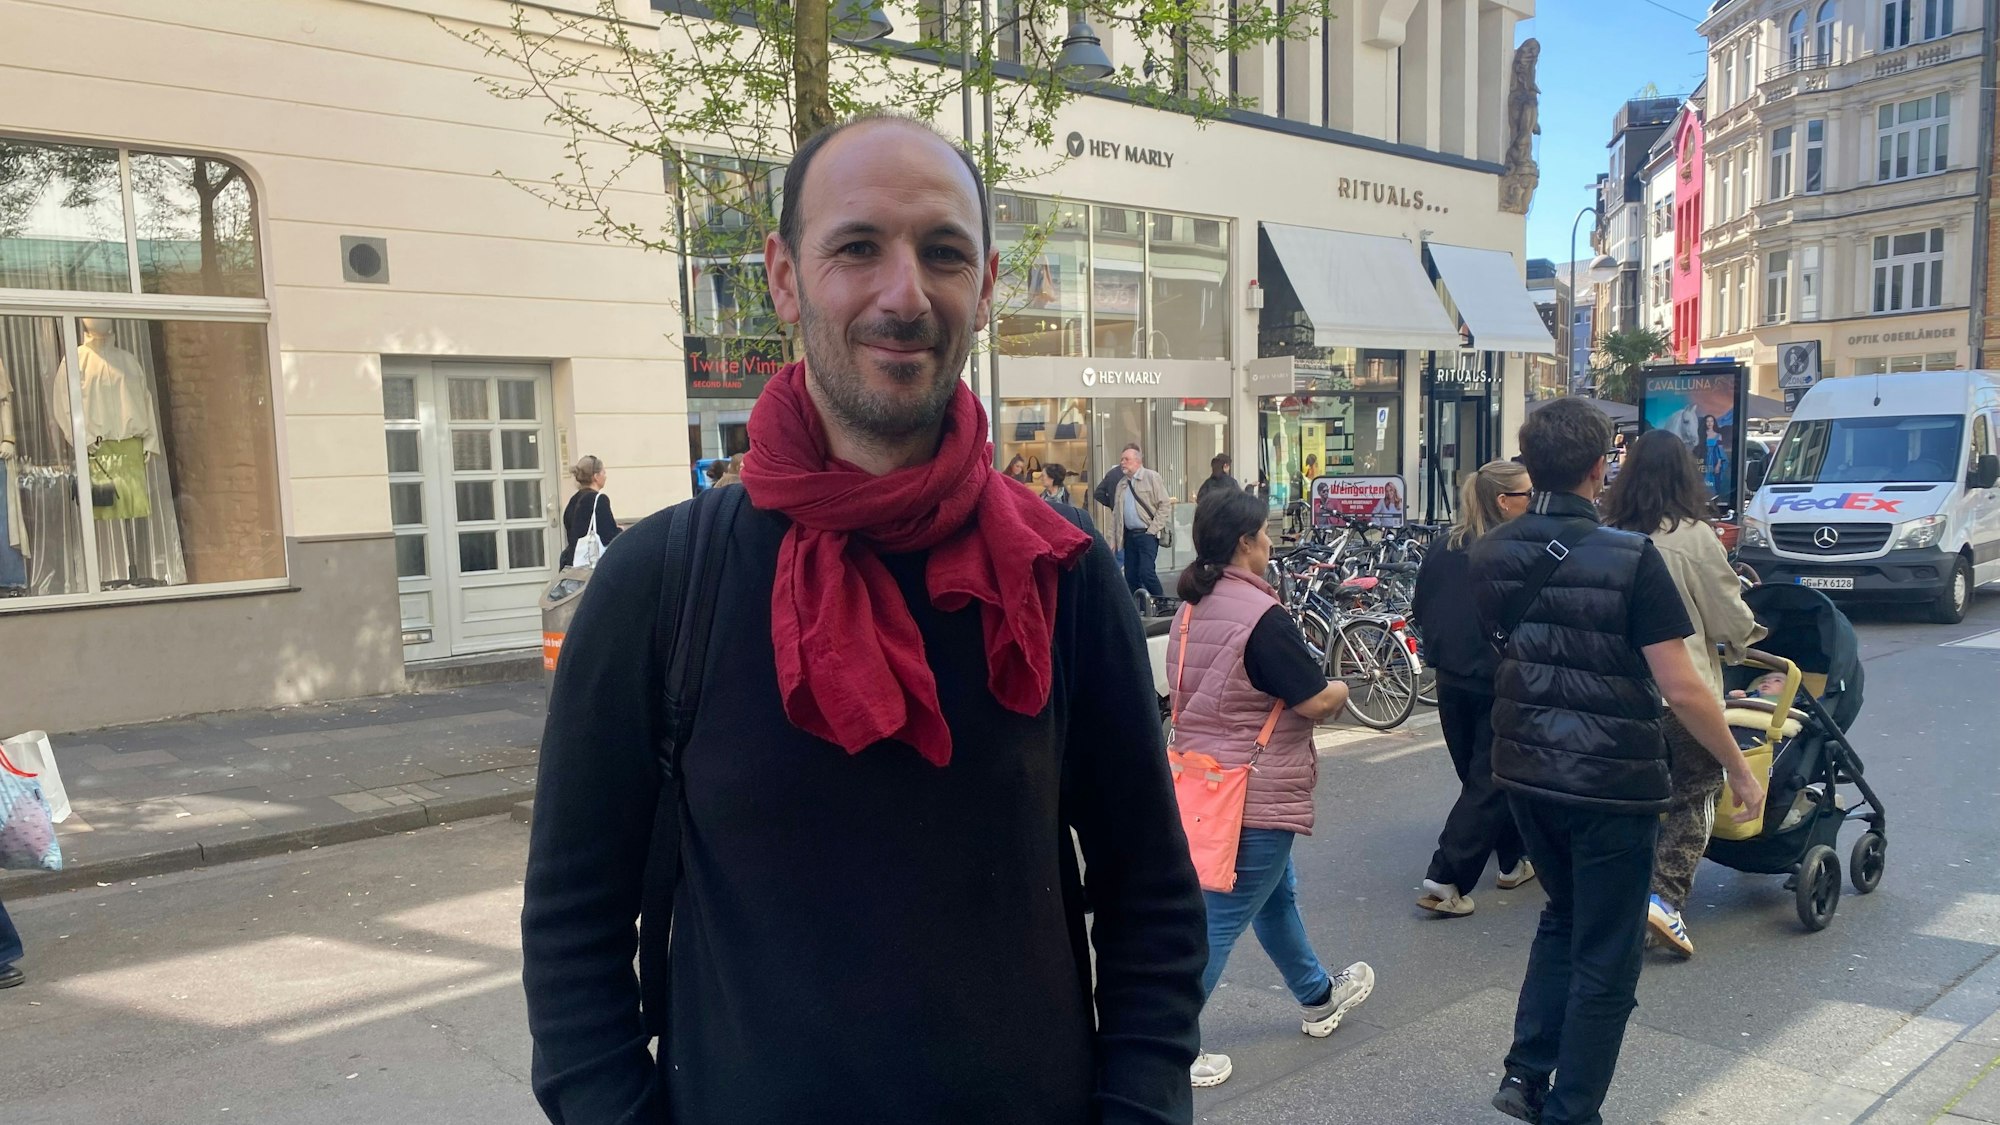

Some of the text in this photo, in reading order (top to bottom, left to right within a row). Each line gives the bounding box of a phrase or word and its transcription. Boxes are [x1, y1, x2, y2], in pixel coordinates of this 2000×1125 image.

[1089, 139, 1174, 168] HEY MARLY
[1338, 177, 1449, 214] RITUALS...
[1848, 328, 1956, 345] OPTIK OBERLÄNDER
[690, 352, 740, 374] Twice
[1099, 371, 1162, 385] HEY MARLY
[1647, 378, 1711, 392] CAVALLUNA
[1330, 485, 1384, 496] Weingarten
[1768, 493, 1904, 514] FedEx
[1830, 579, 1852, 588] 6128
